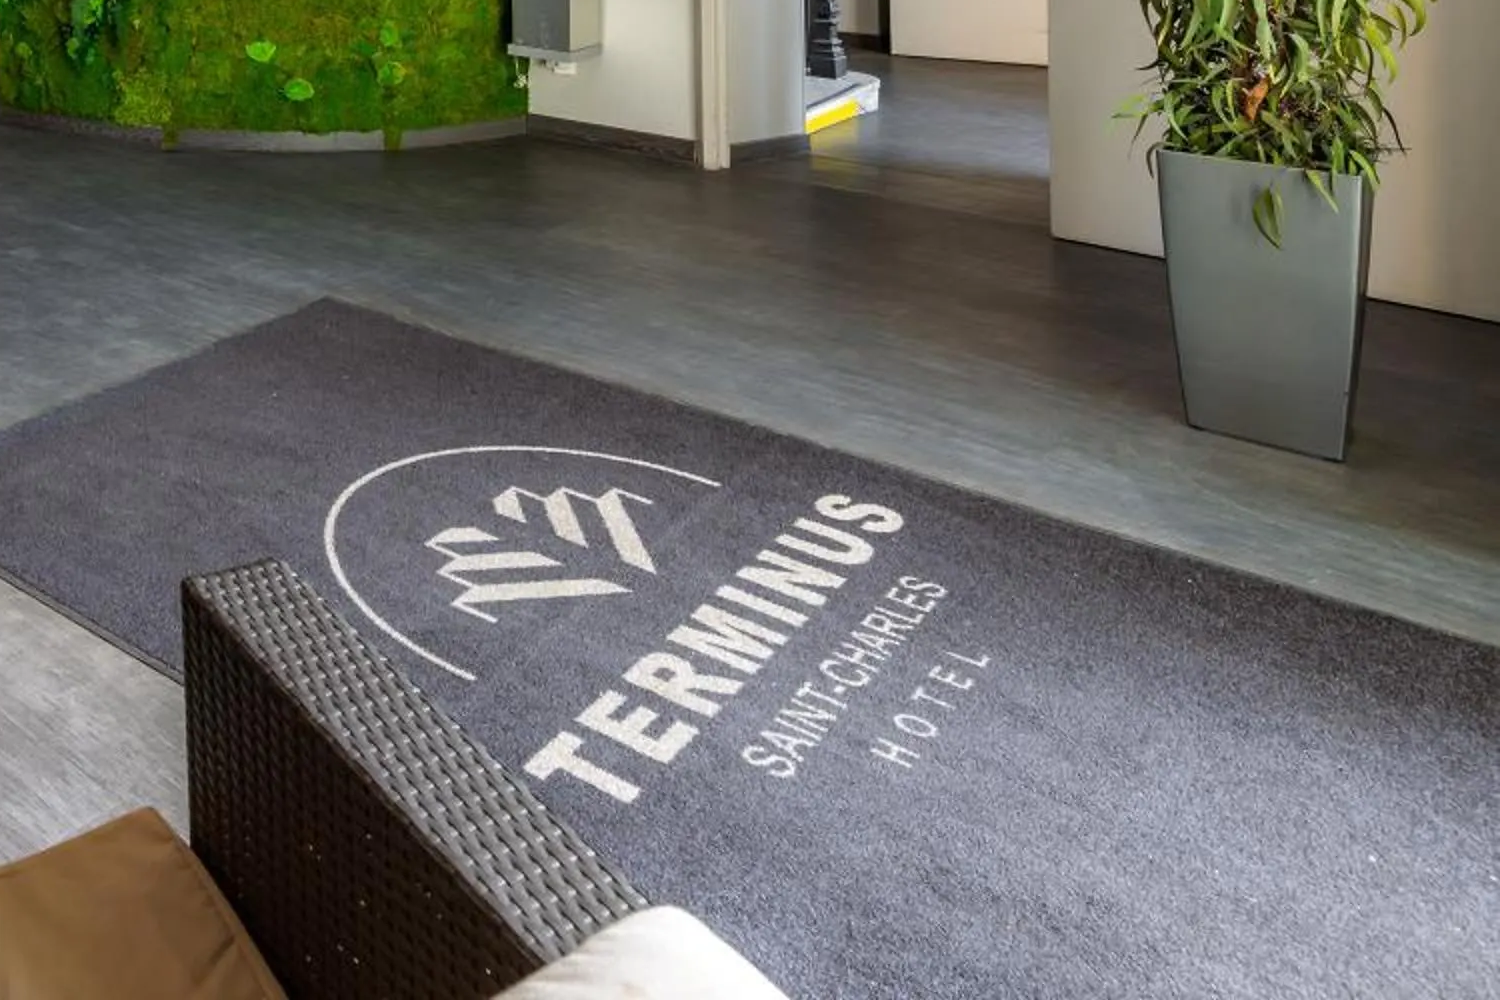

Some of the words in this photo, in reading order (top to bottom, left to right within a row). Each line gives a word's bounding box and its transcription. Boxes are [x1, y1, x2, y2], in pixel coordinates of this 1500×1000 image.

[524, 495, 904, 804] TERMINUS
[741, 576, 947, 778] SAINT-CHARLES
[870, 651, 991, 769] HOTEL
